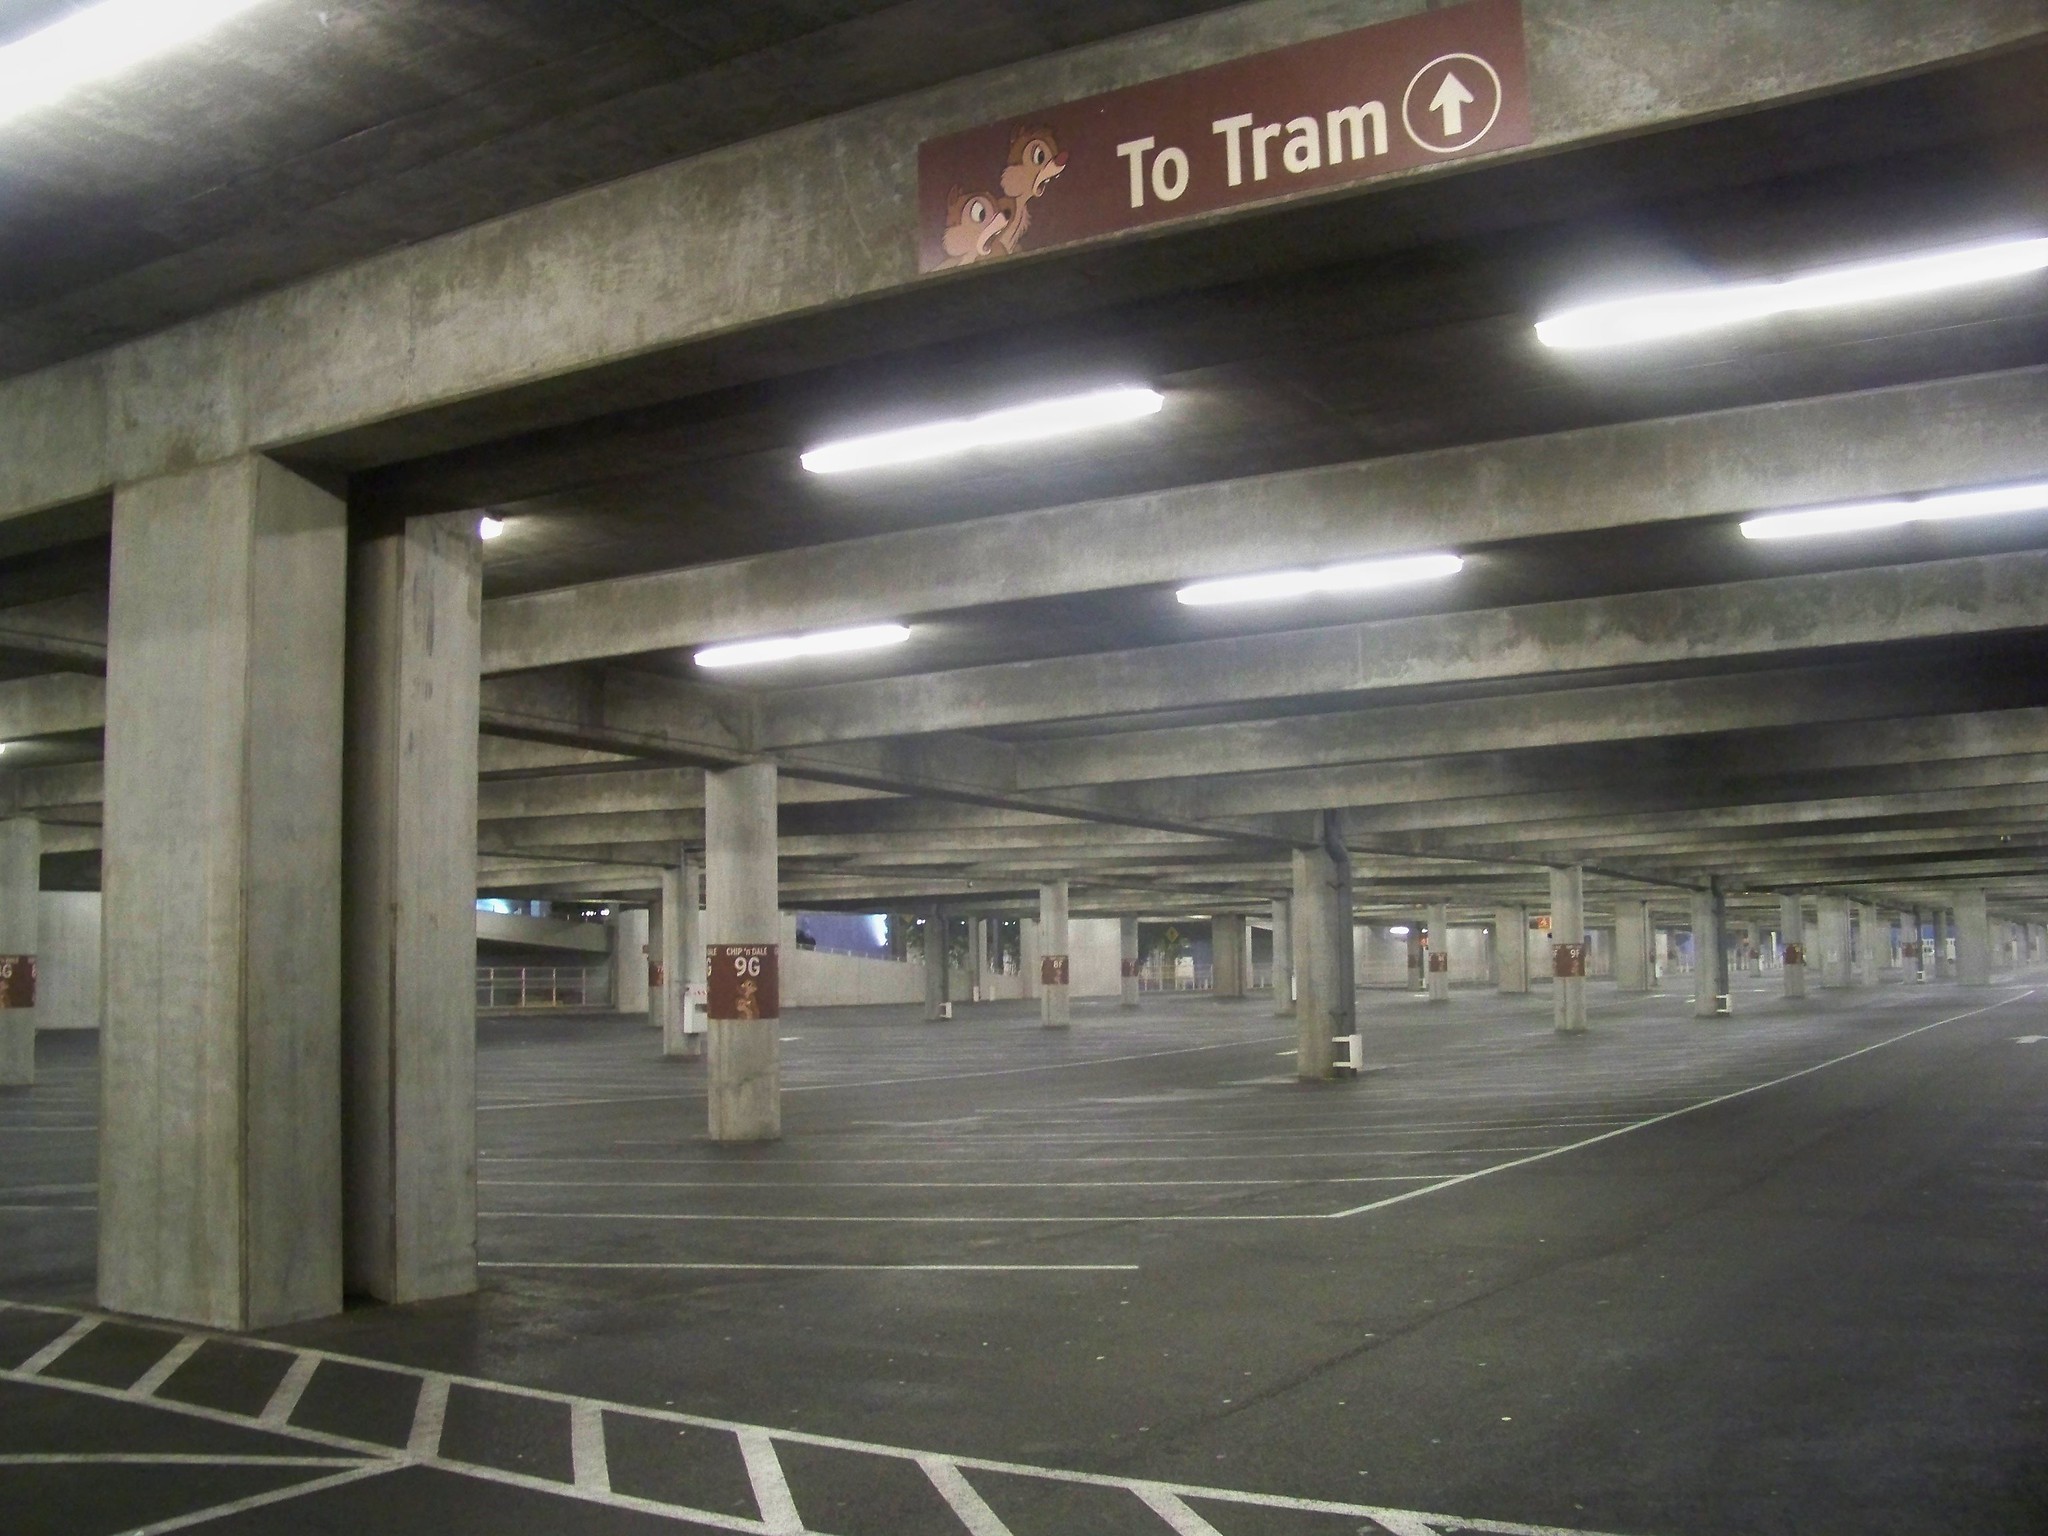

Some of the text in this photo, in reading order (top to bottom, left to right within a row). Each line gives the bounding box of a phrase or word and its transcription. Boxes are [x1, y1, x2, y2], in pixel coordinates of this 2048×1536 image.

[1117, 99, 1388, 208] To Tram
[726, 947, 742, 956] CHIP
[752, 947, 768, 956] DALE
[734, 956, 760, 977] 9G
